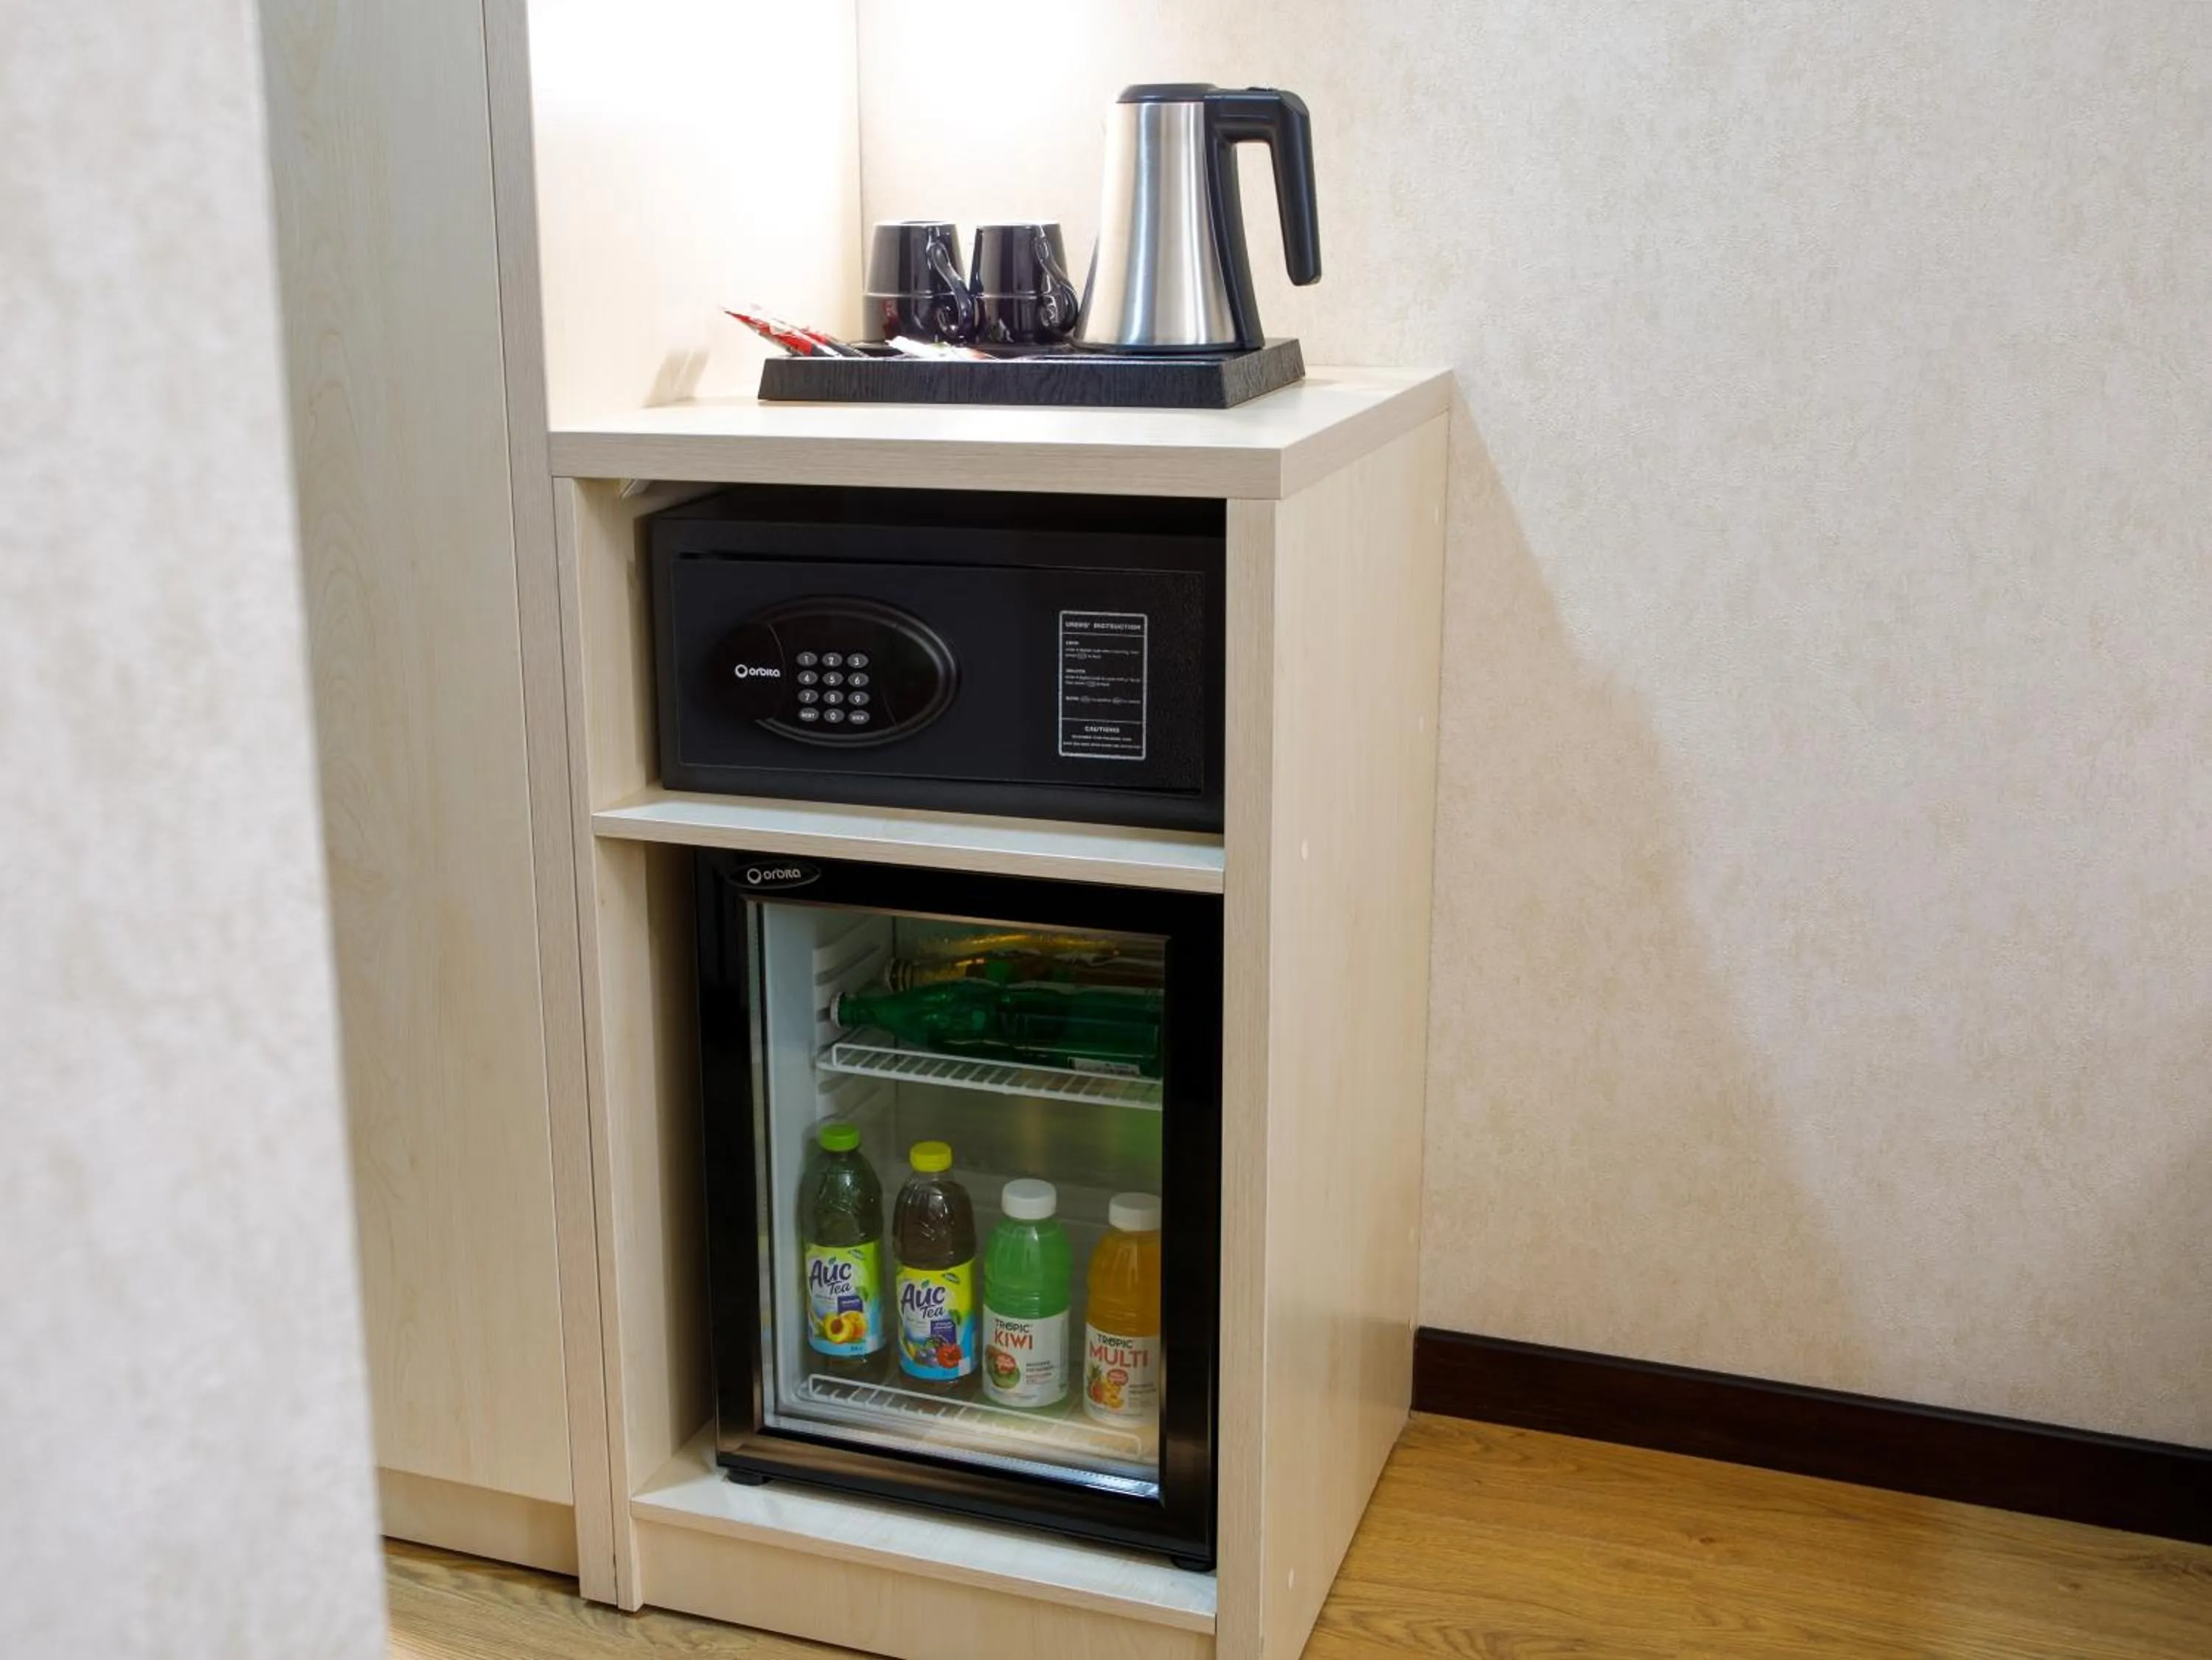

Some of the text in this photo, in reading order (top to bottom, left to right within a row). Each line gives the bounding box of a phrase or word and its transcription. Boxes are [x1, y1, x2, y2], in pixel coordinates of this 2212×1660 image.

[827, 1281, 852, 1295] Tea
[919, 1305, 945, 1319] Tea
[995, 1319, 1030, 1333] TROPIC
[993, 1330, 1033, 1350] KIWI
[1089, 1342, 1149, 1368] MULTI
